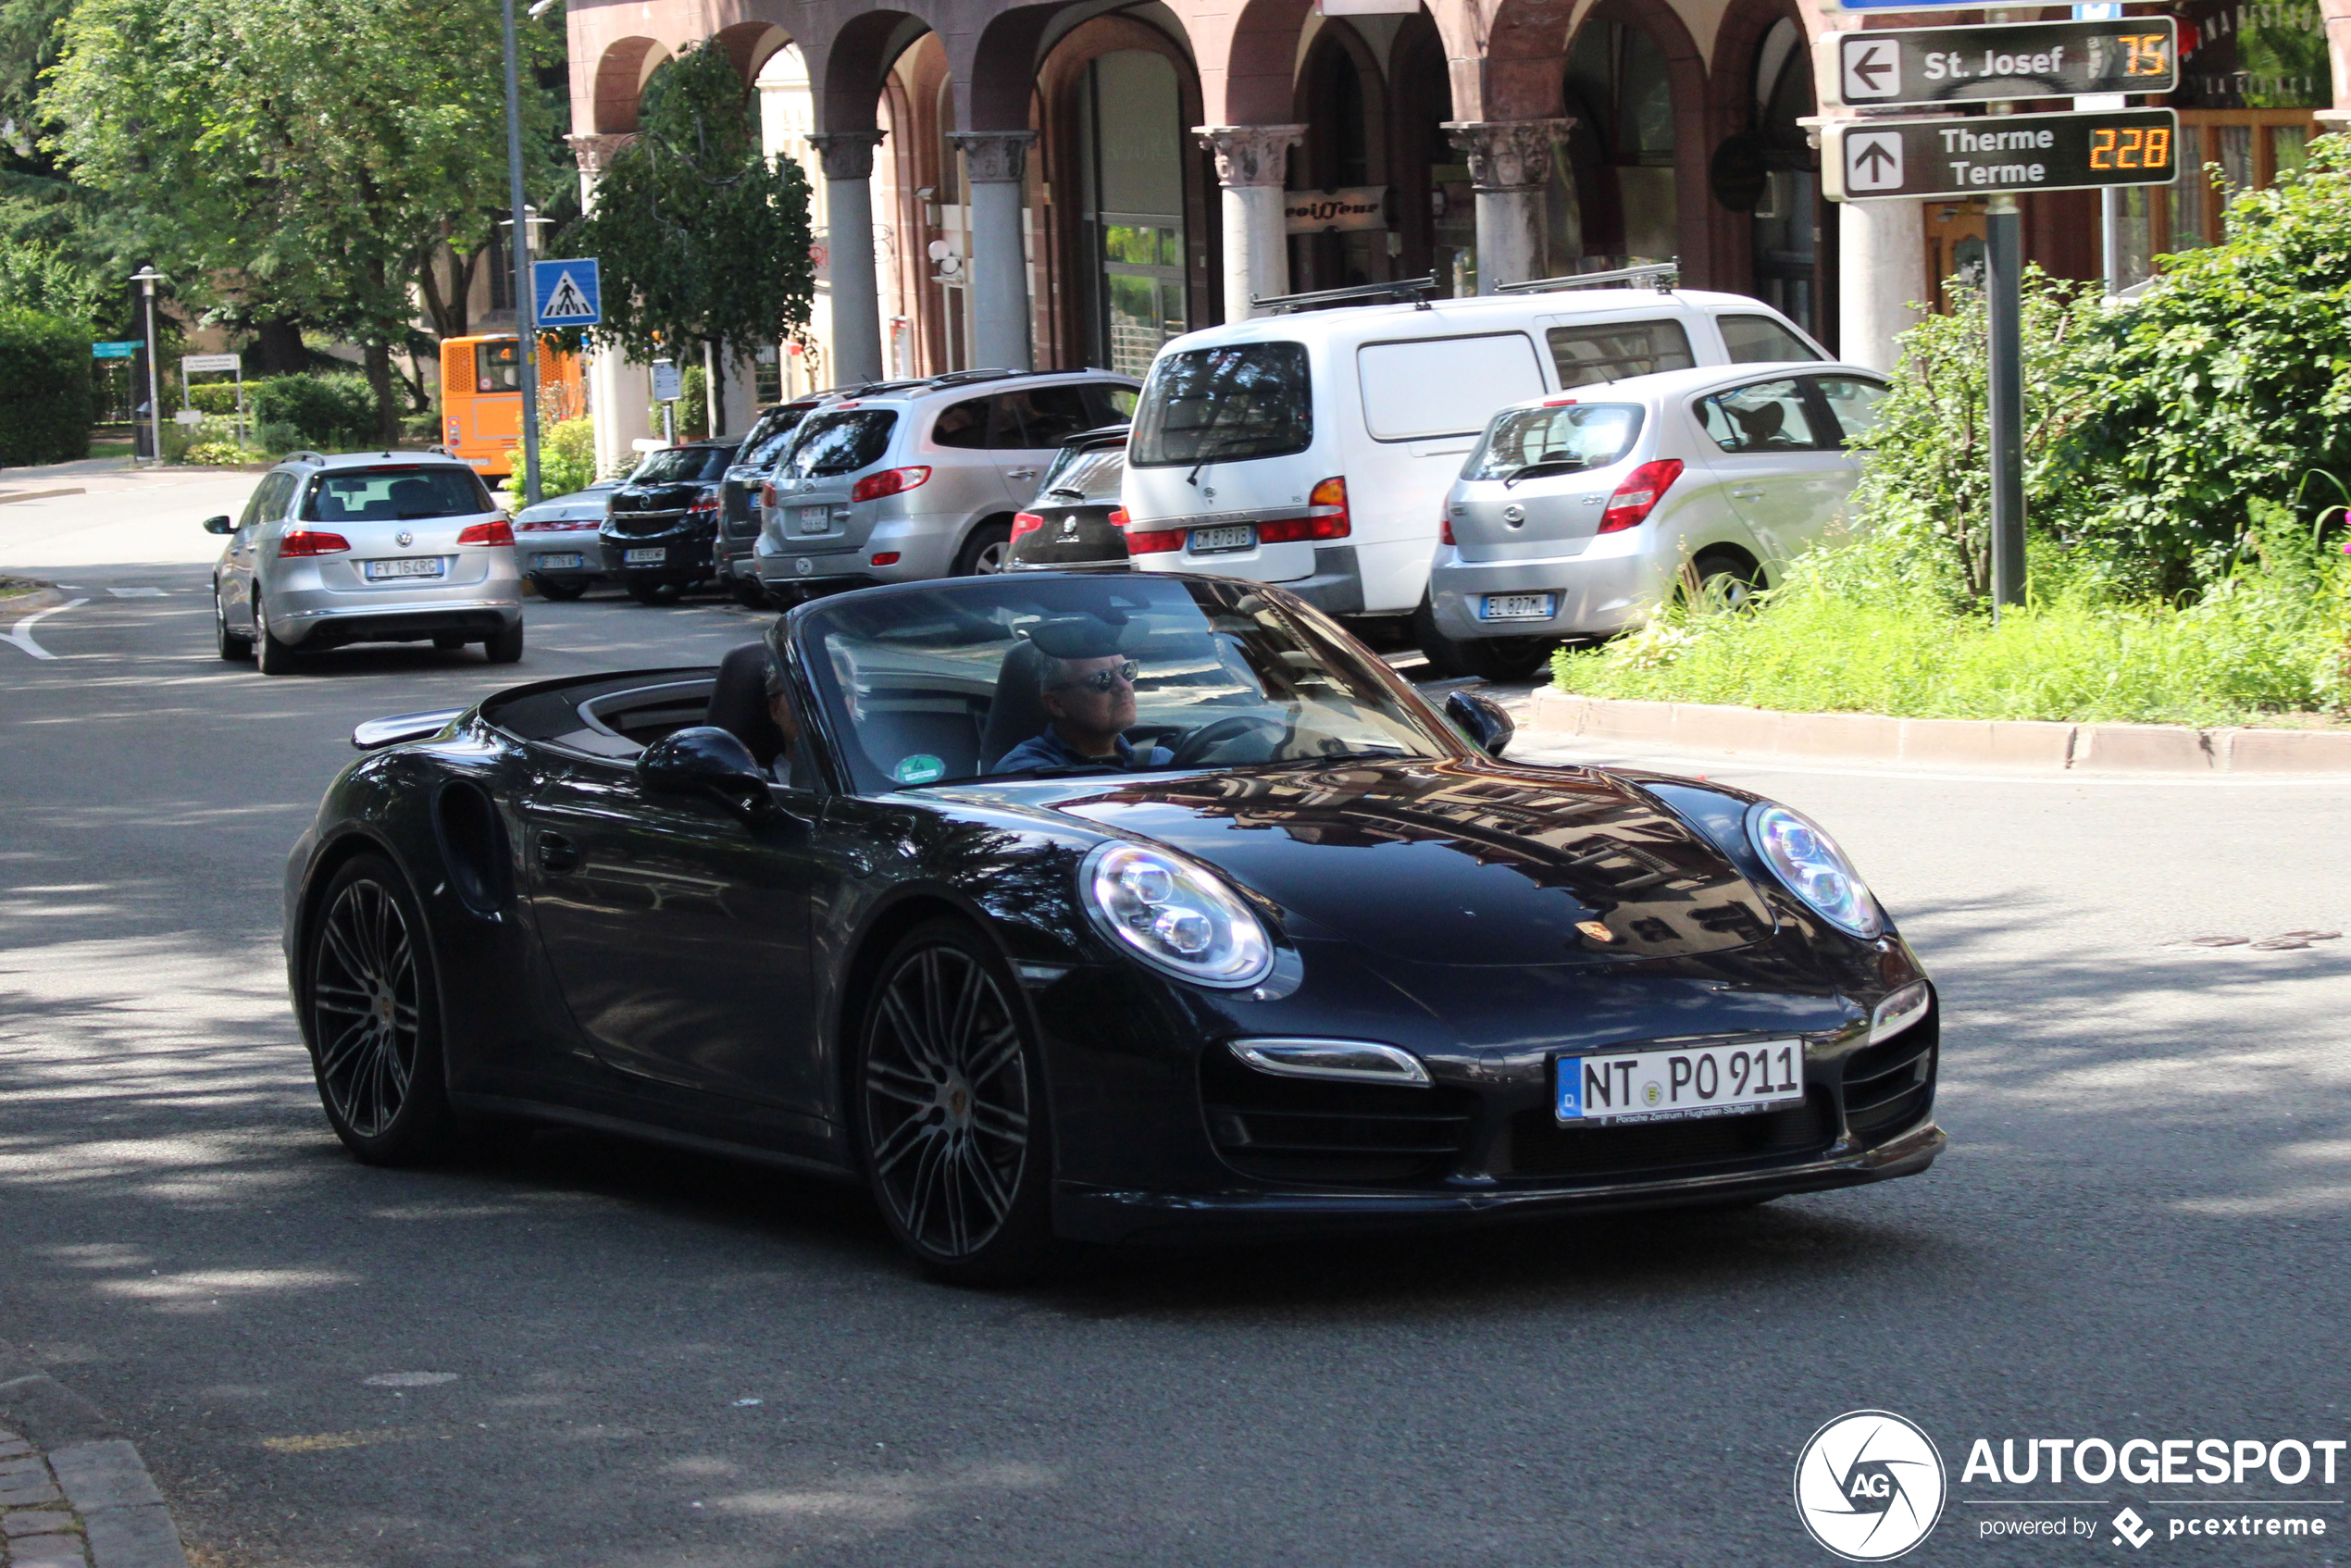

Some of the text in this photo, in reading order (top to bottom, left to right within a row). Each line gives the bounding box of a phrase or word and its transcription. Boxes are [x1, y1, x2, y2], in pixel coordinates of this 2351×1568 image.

[1923, 45, 2064, 80] St. Josef
[2118, 35, 2166, 74] 75
[1939, 126, 2054, 154] Therme
[2089, 129, 2170, 169] 228
[1949, 161, 2046, 186] Terme
[1196, 530, 1210, 547] CM
[1489, 598, 1501, 616] EL
[1585, 1046, 1797, 1109] NT PO 911
[1564, 1094, 1574, 1107] D
[1616, 1103, 1755, 1123] Porsche Zentrum Flughafen Stuttgart
